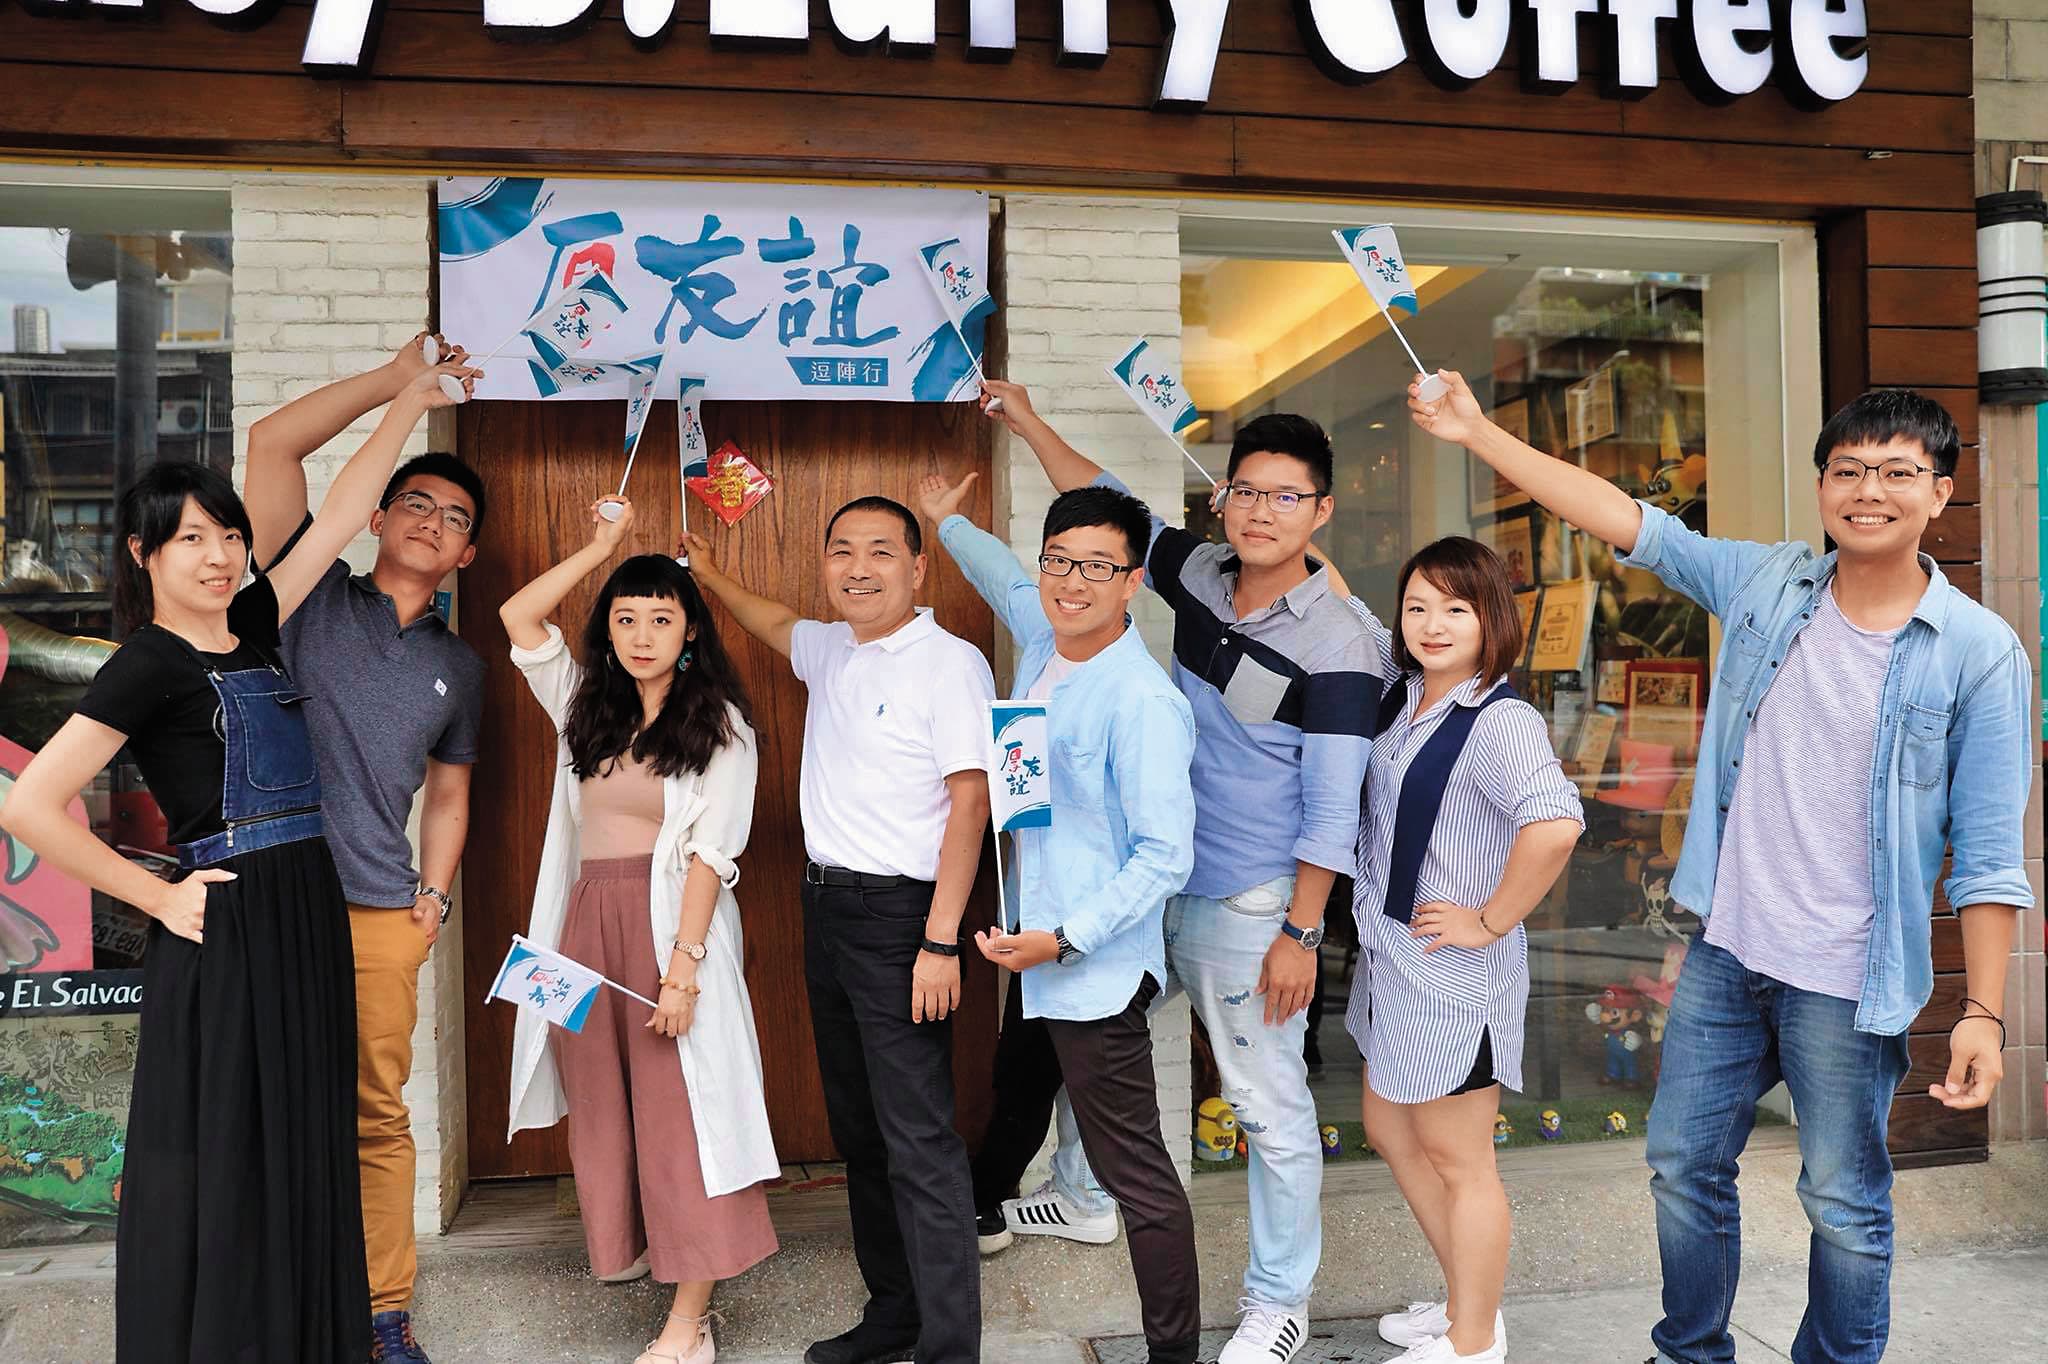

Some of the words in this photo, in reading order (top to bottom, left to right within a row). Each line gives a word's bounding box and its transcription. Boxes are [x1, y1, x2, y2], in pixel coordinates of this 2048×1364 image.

[811, 361, 882, 383] 逗陣行
[1000, 740, 1046, 796] 厚友誼
[11, 979, 42, 1008] El
